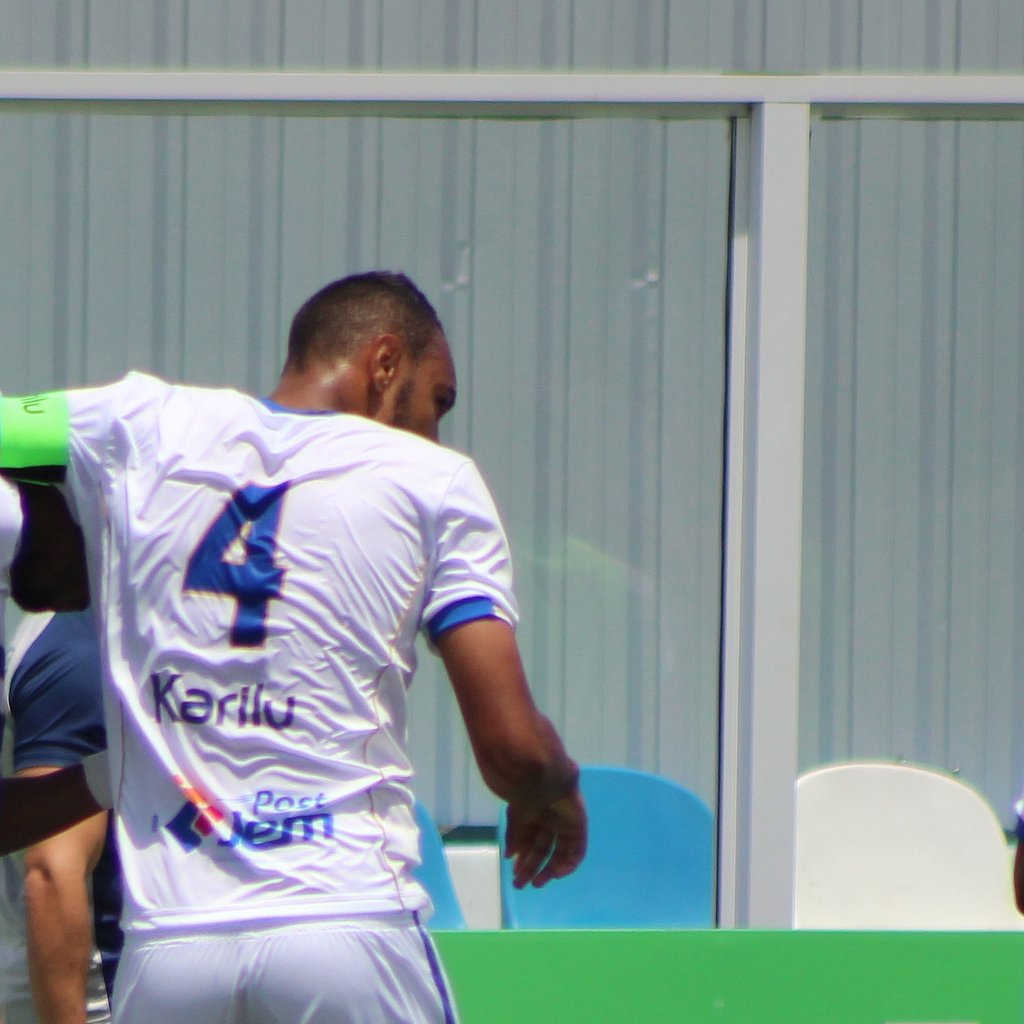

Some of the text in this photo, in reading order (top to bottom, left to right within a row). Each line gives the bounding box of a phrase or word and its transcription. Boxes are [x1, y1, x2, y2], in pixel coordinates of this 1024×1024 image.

[183, 480, 290, 650] 4
[150, 673, 295, 730] Karilu
[252, 790, 327, 815] Post
